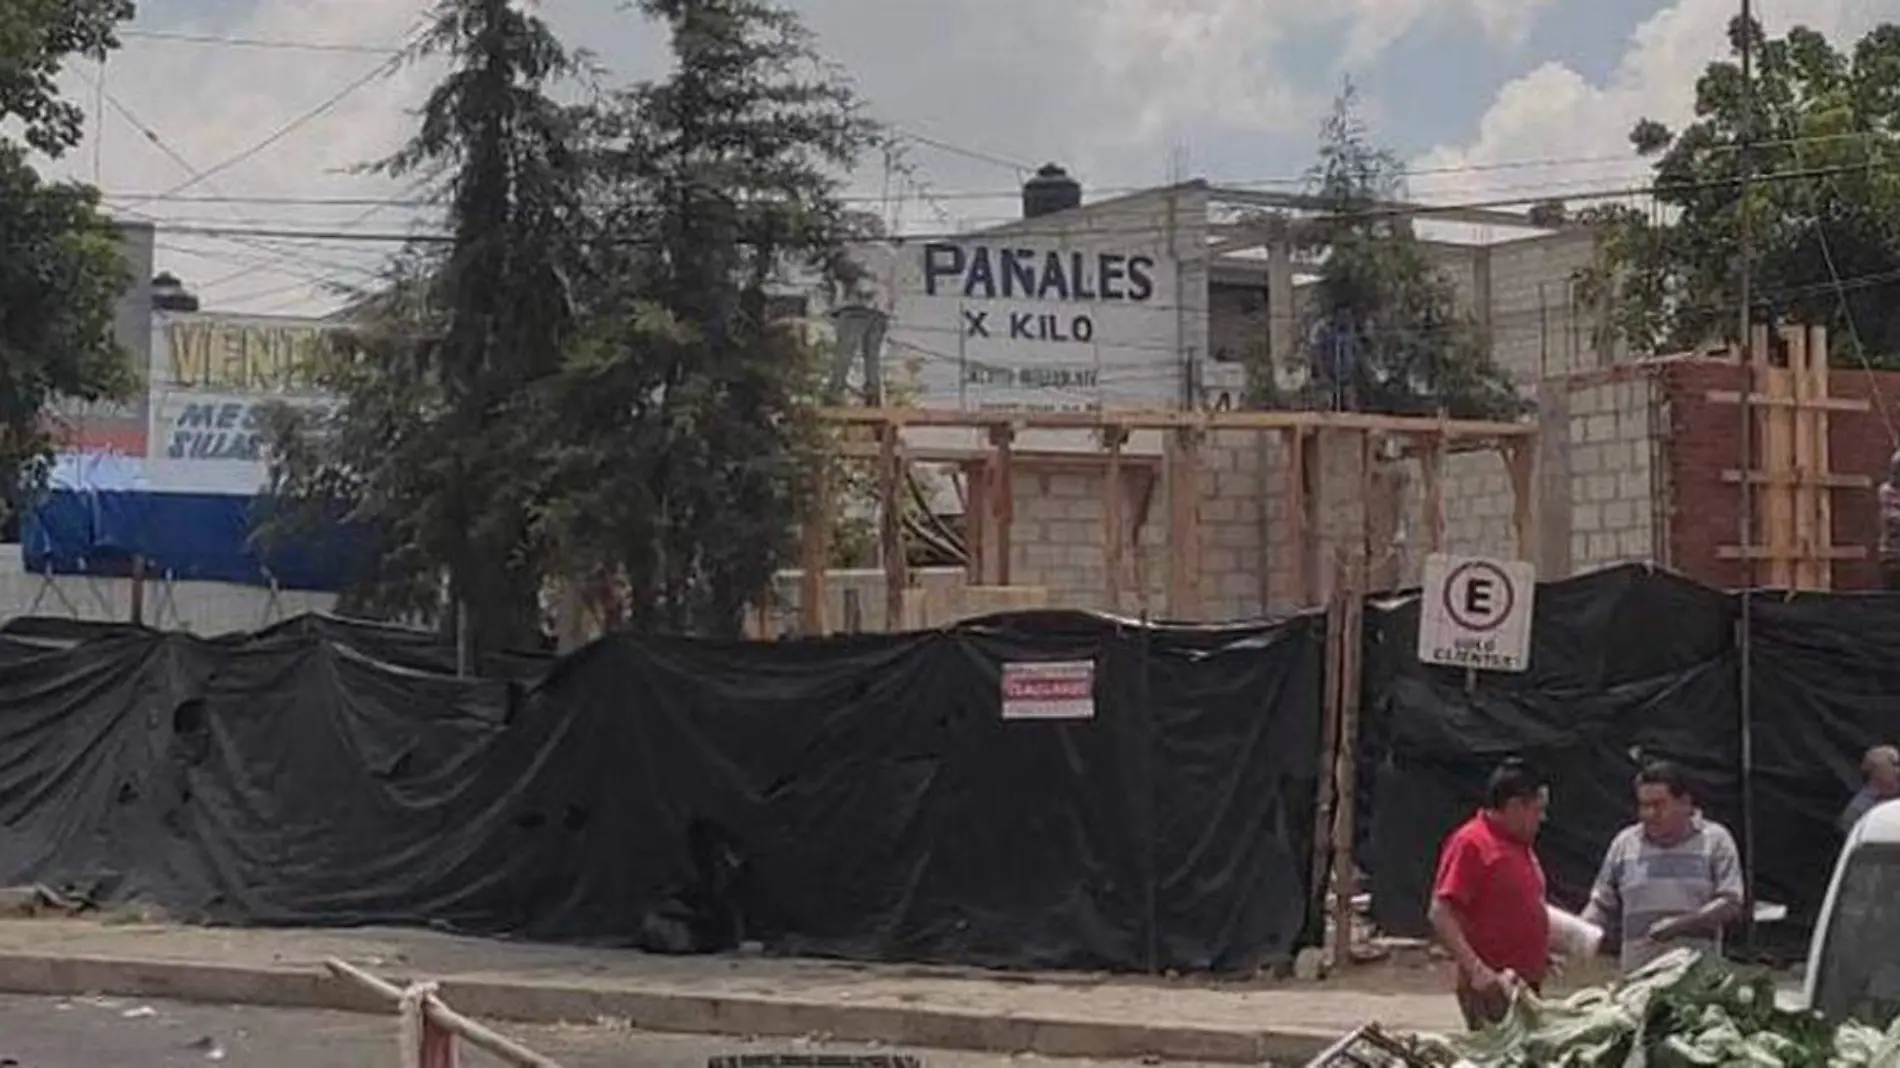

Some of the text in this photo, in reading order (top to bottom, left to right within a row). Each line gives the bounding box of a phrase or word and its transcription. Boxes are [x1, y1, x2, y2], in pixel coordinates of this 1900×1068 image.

[924, 244, 1154, 300] PAÑALES
[965, 310, 1093, 342] X KILO
[1466, 578, 1493, 614] E
